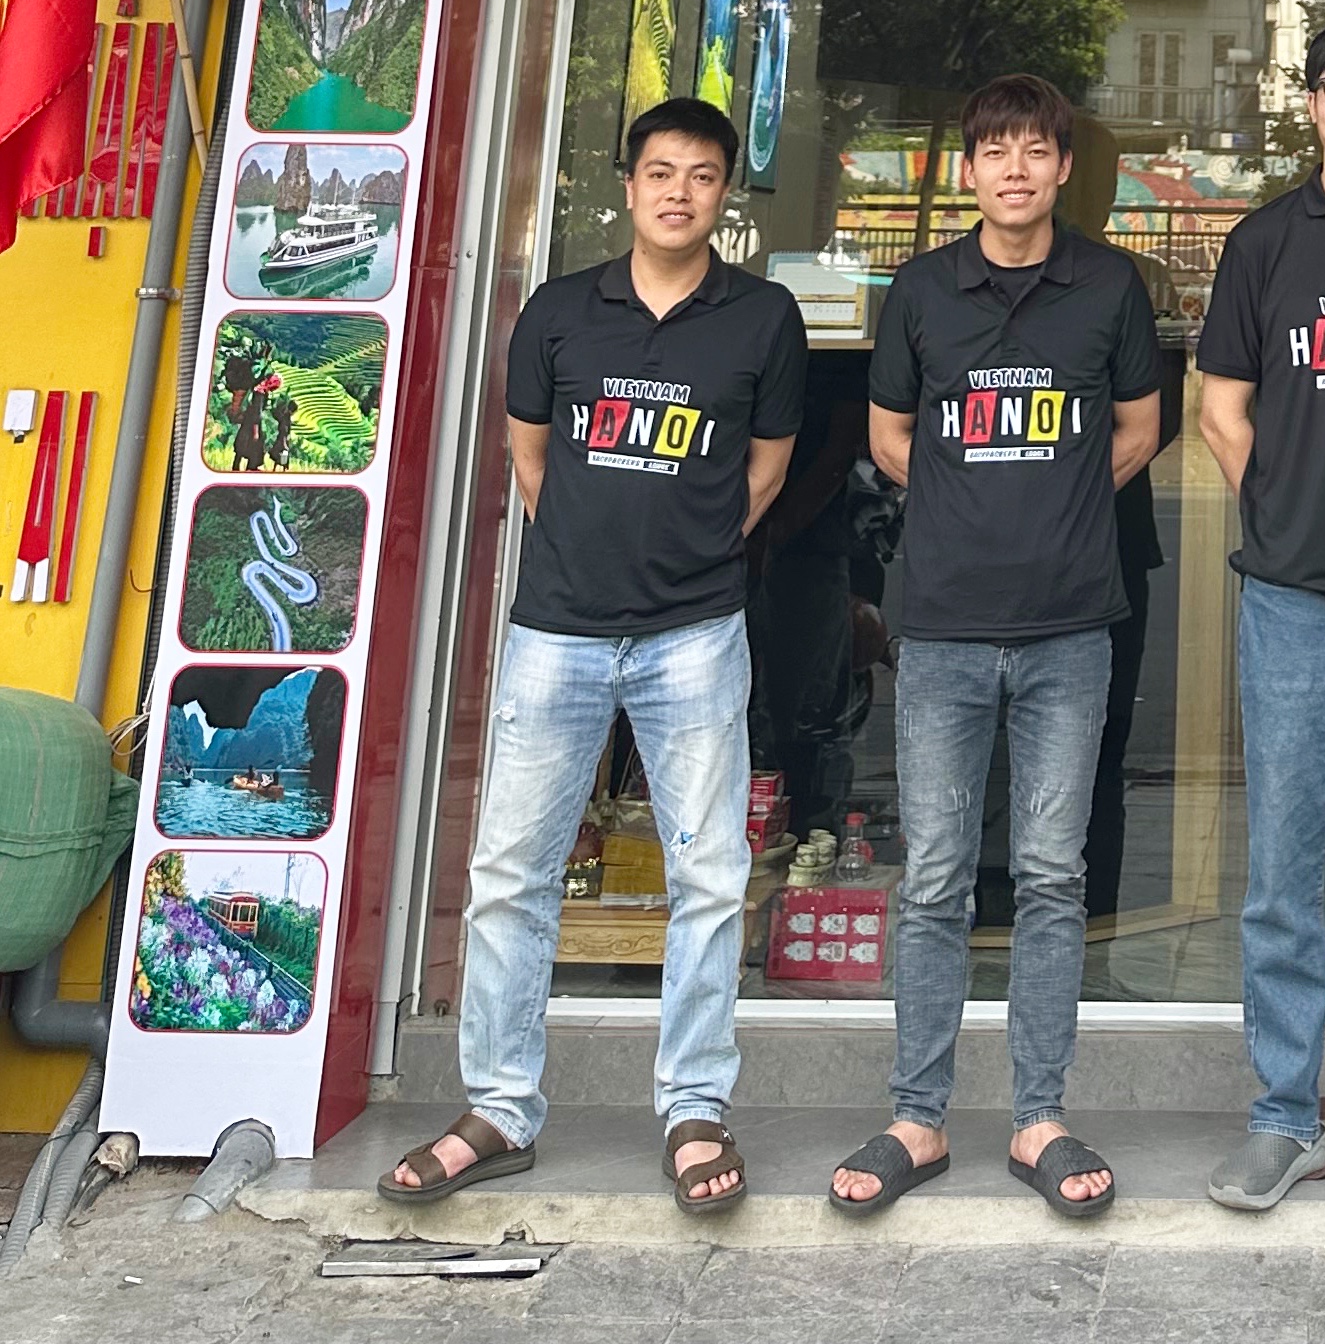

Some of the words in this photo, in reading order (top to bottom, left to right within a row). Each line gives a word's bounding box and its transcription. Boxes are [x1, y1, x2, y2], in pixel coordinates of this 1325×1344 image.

[603, 377, 691, 405] VIETNAM
[968, 367, 1053, 390] VIETNAM
[571, 399, 717, 459] HANOI
[941, 390, 1083, 444] HANOI
